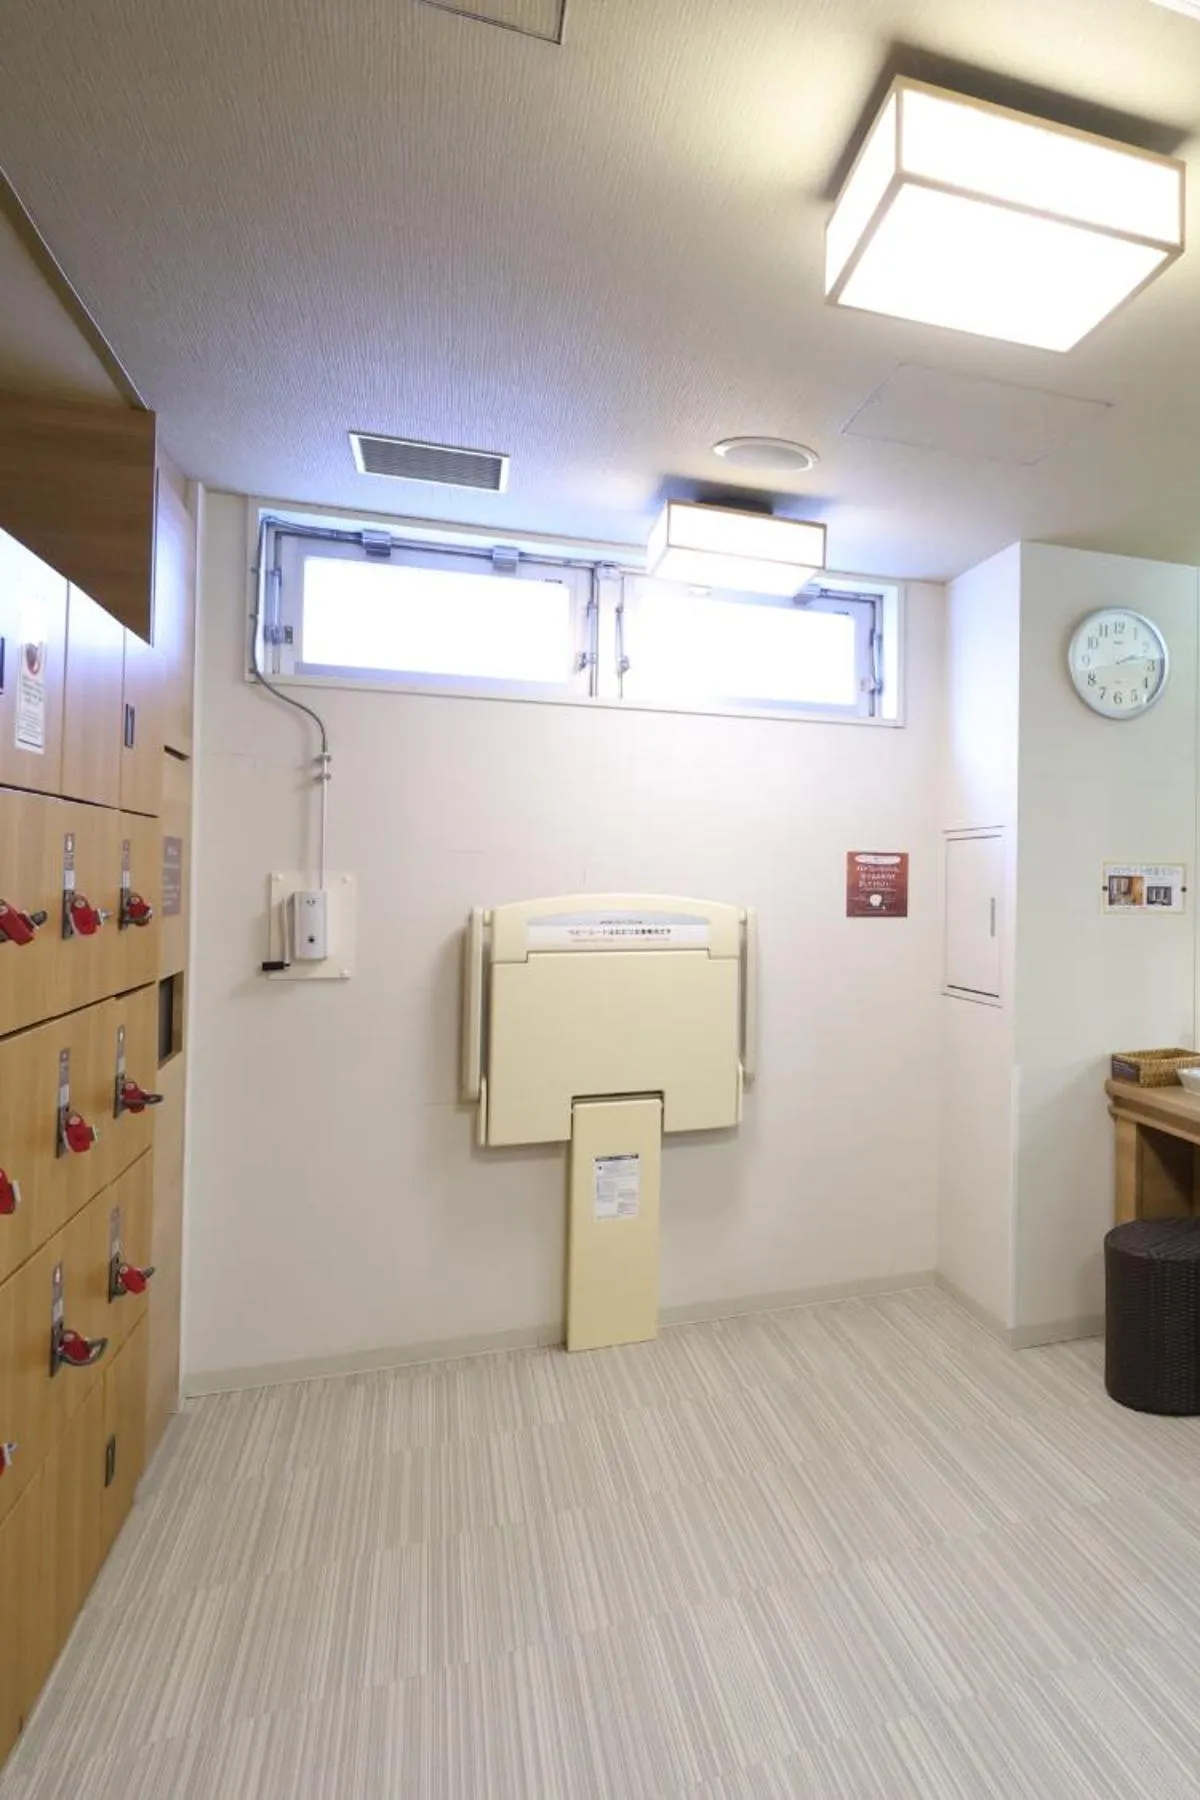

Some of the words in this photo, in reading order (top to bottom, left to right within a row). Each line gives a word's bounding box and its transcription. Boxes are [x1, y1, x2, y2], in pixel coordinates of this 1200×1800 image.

[1099, 623, 1108, 638] 11
[1113, 621, 1125, 634] 12
[1087, 636, 1099, 649] 10
[1081, 654, 1090, 666] 9
[1087, 671, 1097, 686] 8
[1099, 686, 1107, 700] 7
[1113, 690, 1123, 704] 6
[1130, 688, 1139, 703] 5
